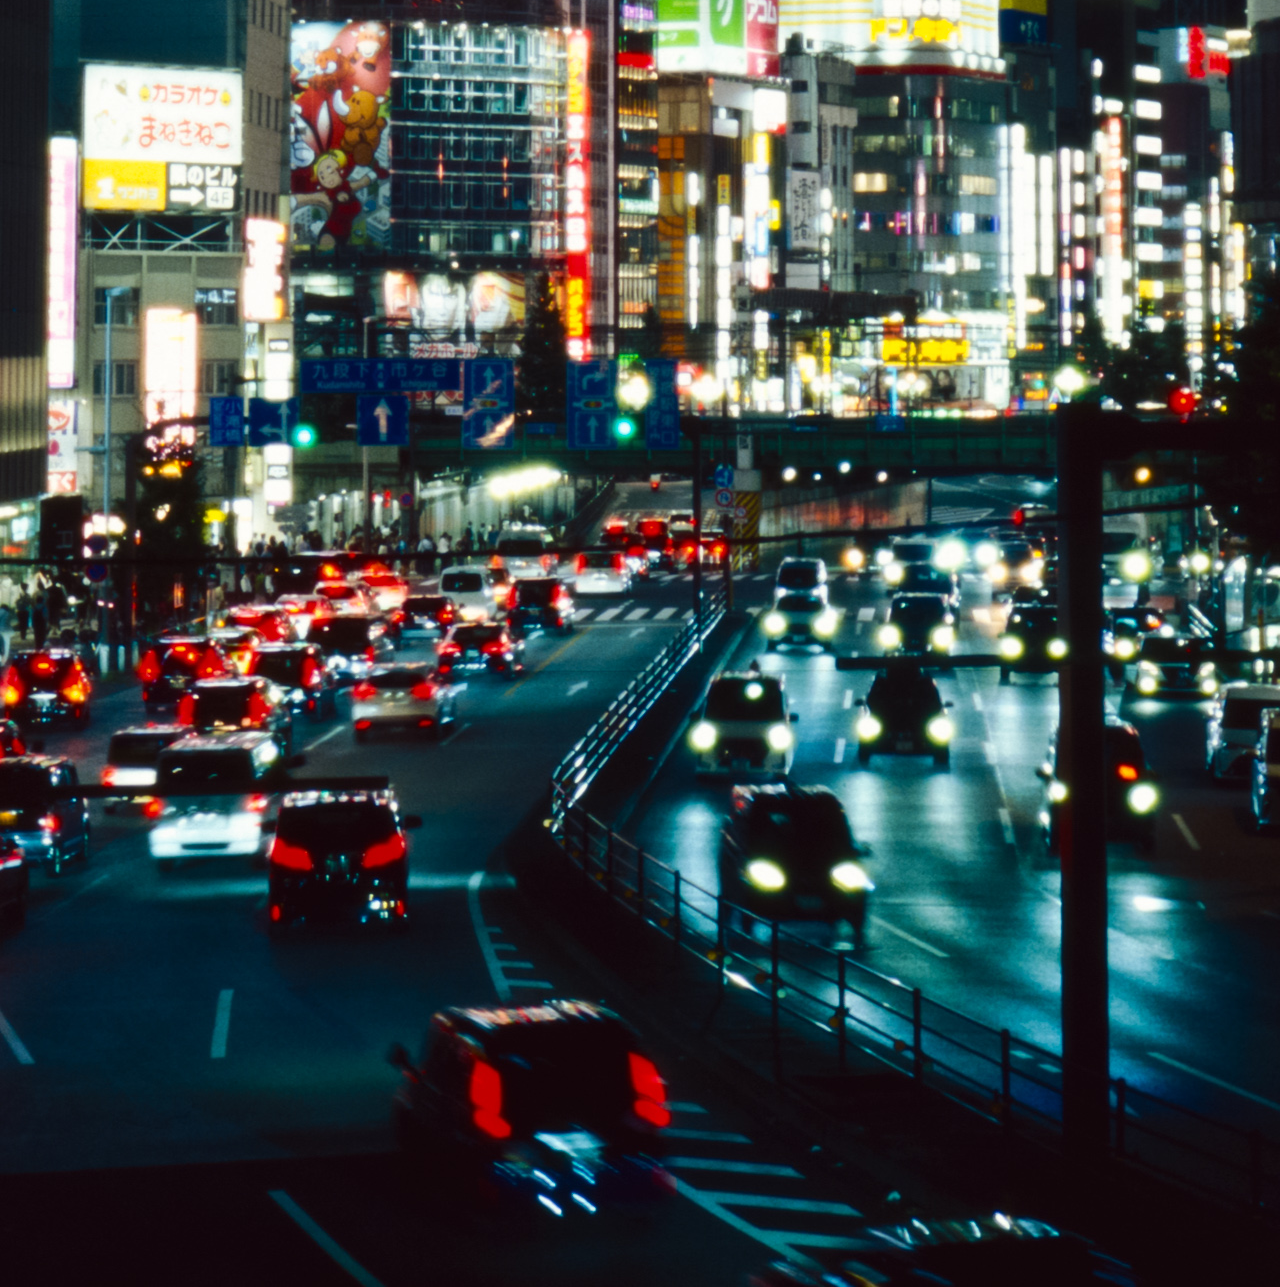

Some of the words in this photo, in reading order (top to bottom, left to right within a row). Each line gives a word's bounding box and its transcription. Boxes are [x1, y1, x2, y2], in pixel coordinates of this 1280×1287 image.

[152, 83, 218, 106] カラオケ
[138, 114, 231, 149] まねきねこ
[210, 191, 231, 203] 4F
[312, 364, 370, 380] 九段下
